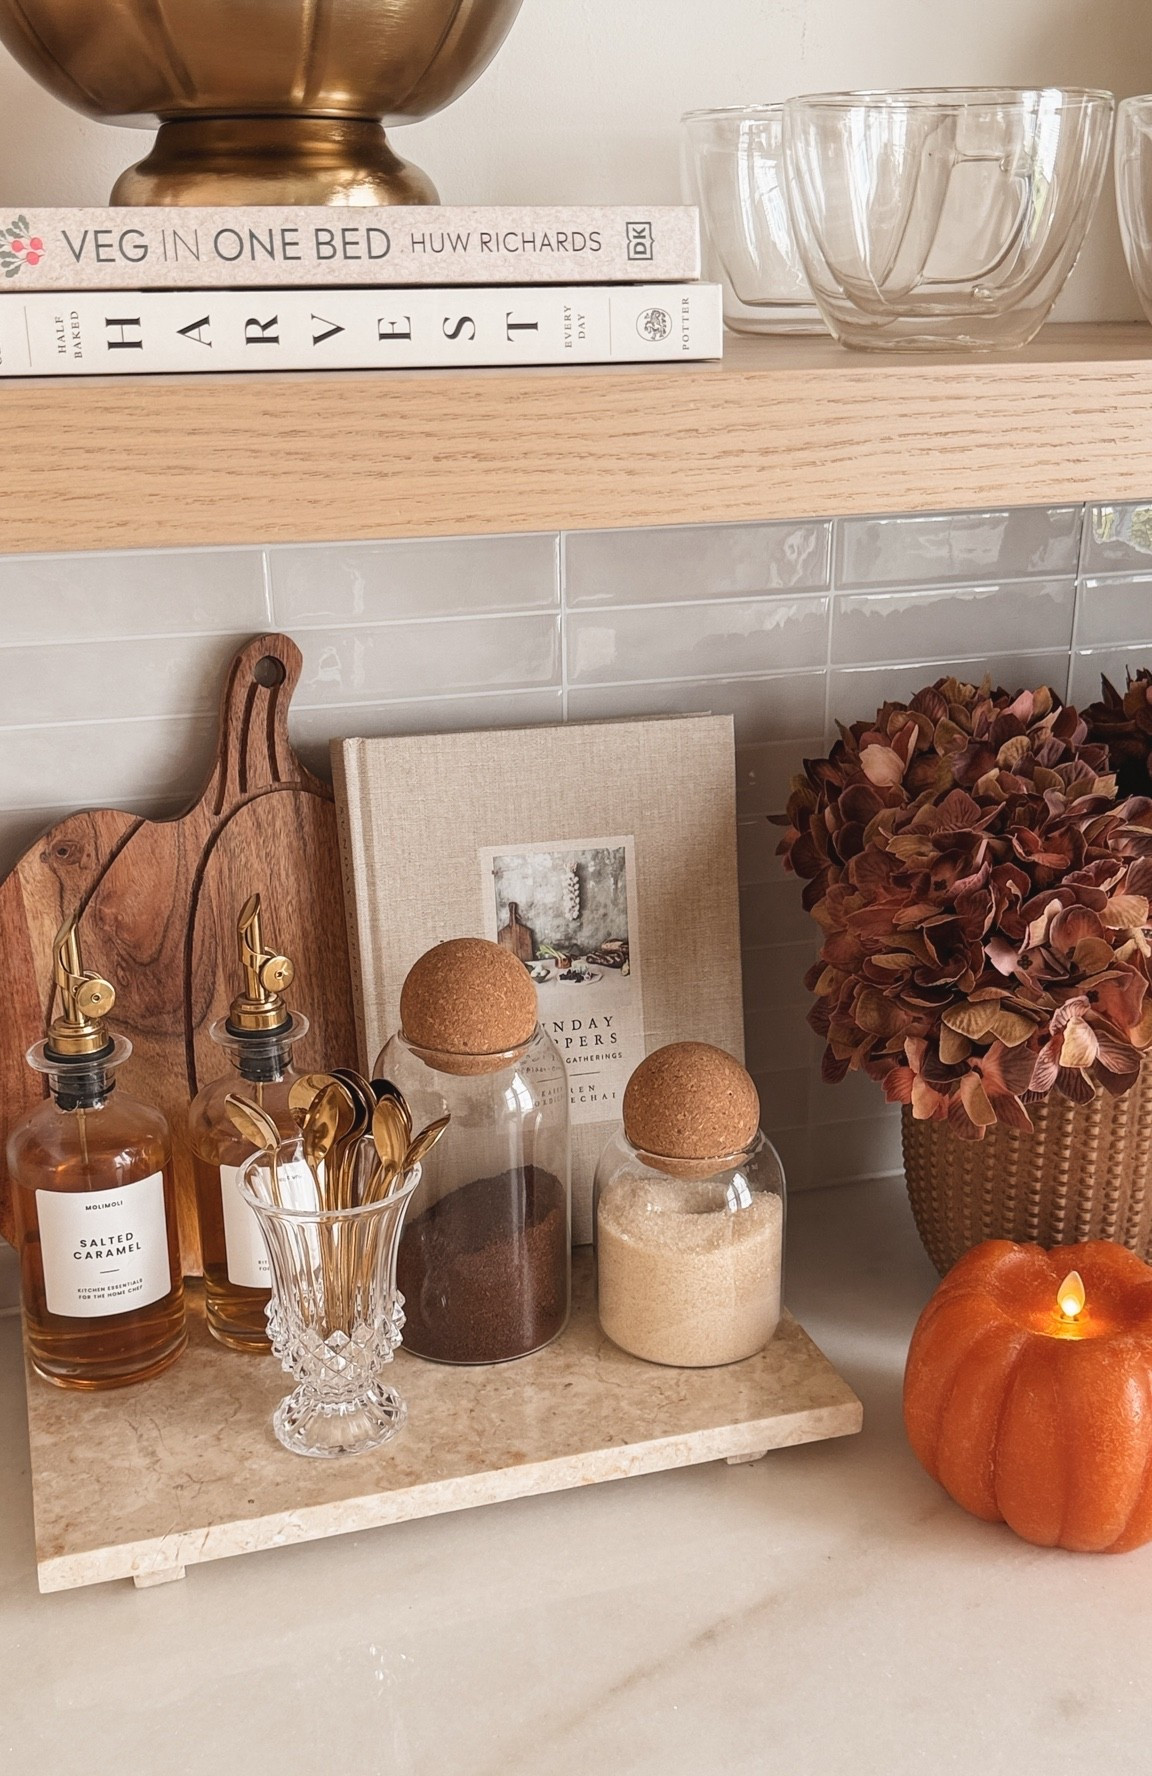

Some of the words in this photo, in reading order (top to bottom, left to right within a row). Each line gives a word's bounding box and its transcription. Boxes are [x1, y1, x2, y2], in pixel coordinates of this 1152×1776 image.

[61, 228, 149, 264] VEG
[161, 228, 201, 262] IN
[213, 228, 302, 262] ONE
[314, 227, 391, 261] BED
[410, 232, 471, 254] HUW
[479, 231, 602, 253] RICHARDS
[632, 226, 648, 256] DK
[54, 316, 67, 354] HALF
[70, 310, 83, 359] BAKED
[104, 311, 539, 351] HARVEST
[563, 305, 573, 348] EVERY
[577, 313, 586, 340] DAY
[681, 297, 690, 351] POTTER
[541, 1016, 613, 1032] NDAY
[555, 1033, 618, 1048] PERS
[566, 1052, 622, 1064] GATHERINGS
[85, 1200, 123, 1211] MOLIMOLI
[73, 1242, 141, 1260] CARAMEL
[80, 1232, 134, 1248] SALTED
[107, 1278, 143, 1291] ESSENTIALS
[107, 1290, 125, 1298] HOME
[128, 1285, 143, 1294] CHEF
